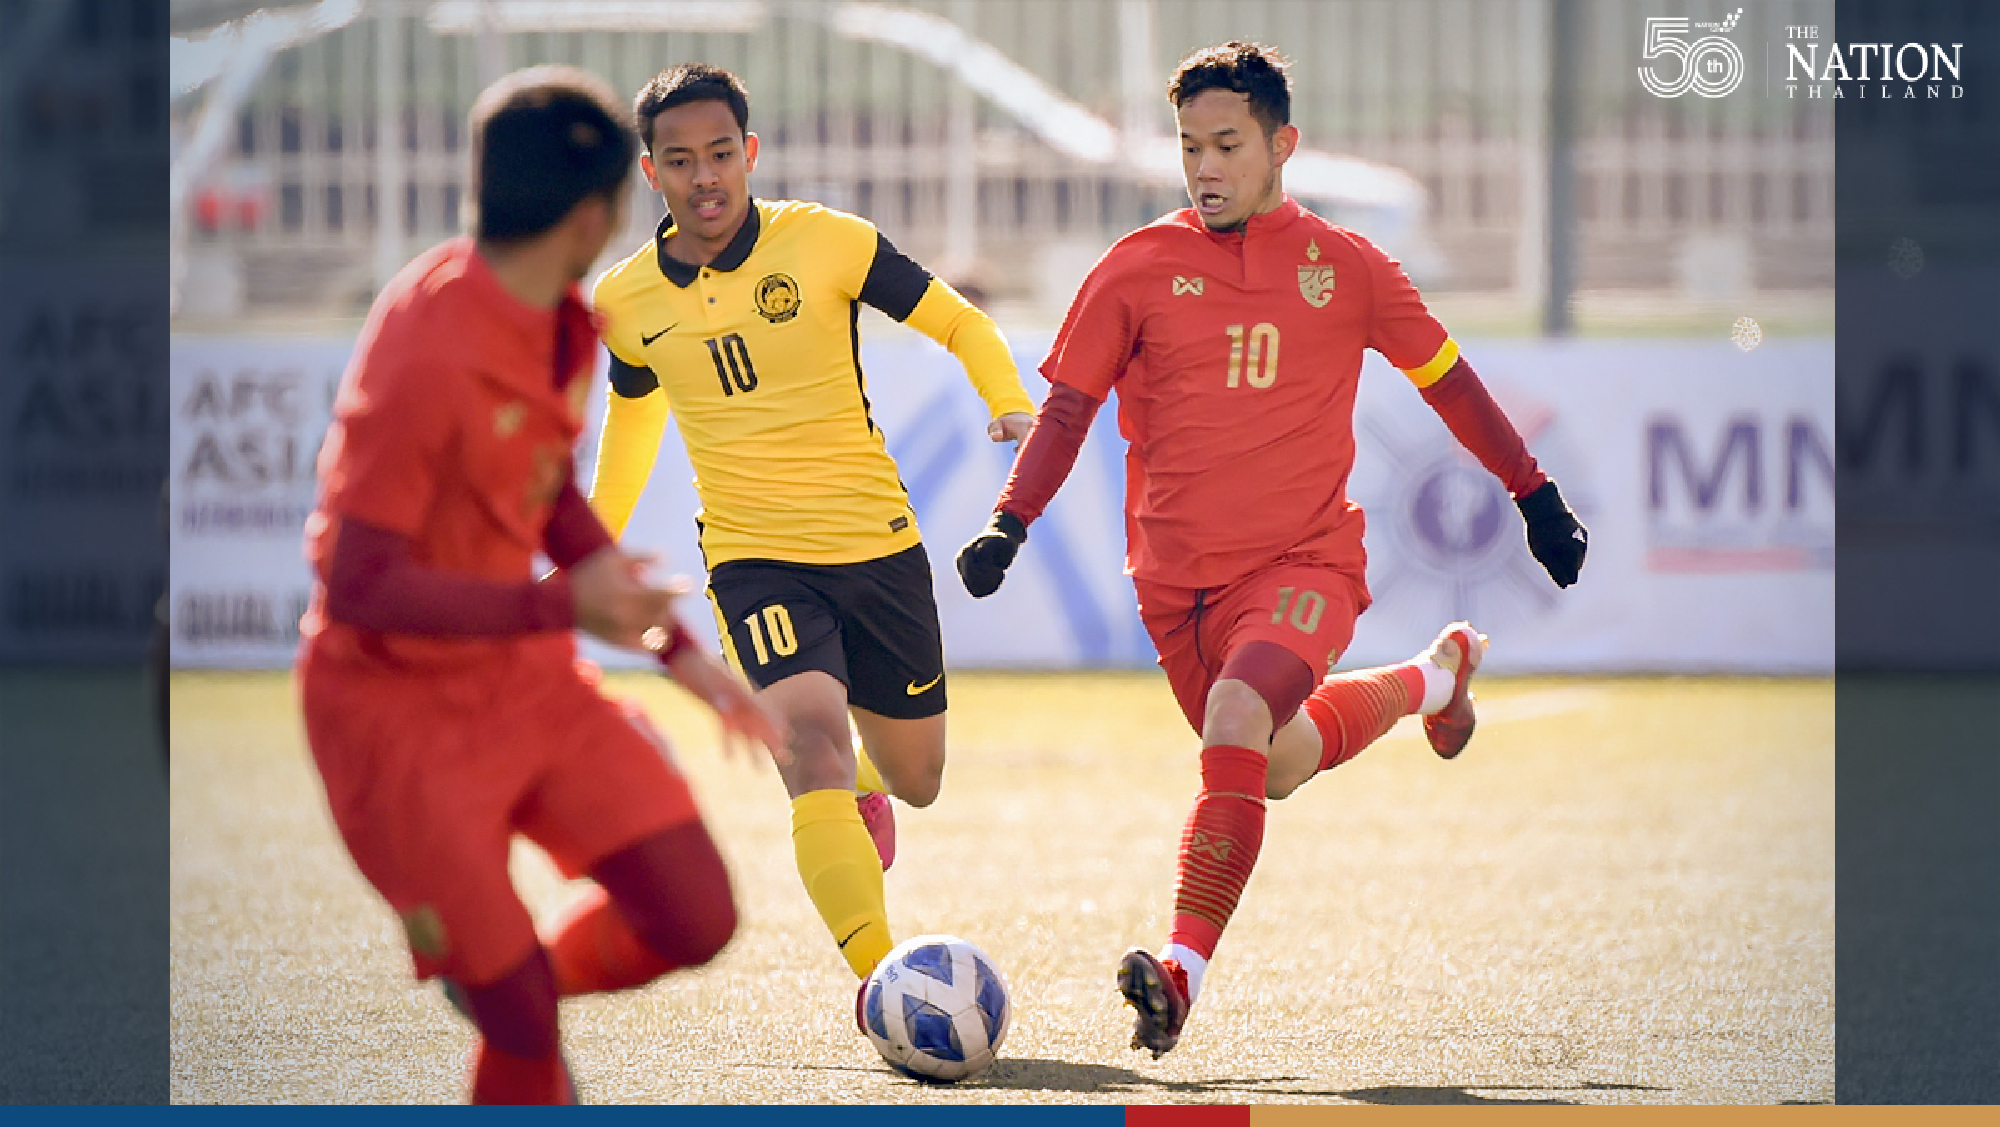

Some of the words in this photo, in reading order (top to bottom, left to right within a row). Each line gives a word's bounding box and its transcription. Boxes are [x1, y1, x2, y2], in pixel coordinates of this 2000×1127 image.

[703, 332, 758, 397] 10
[1225, 322, 1280, 389] 10
[744, 603, 798, 667] 10
[1271, 586, 1326, 635] 10
